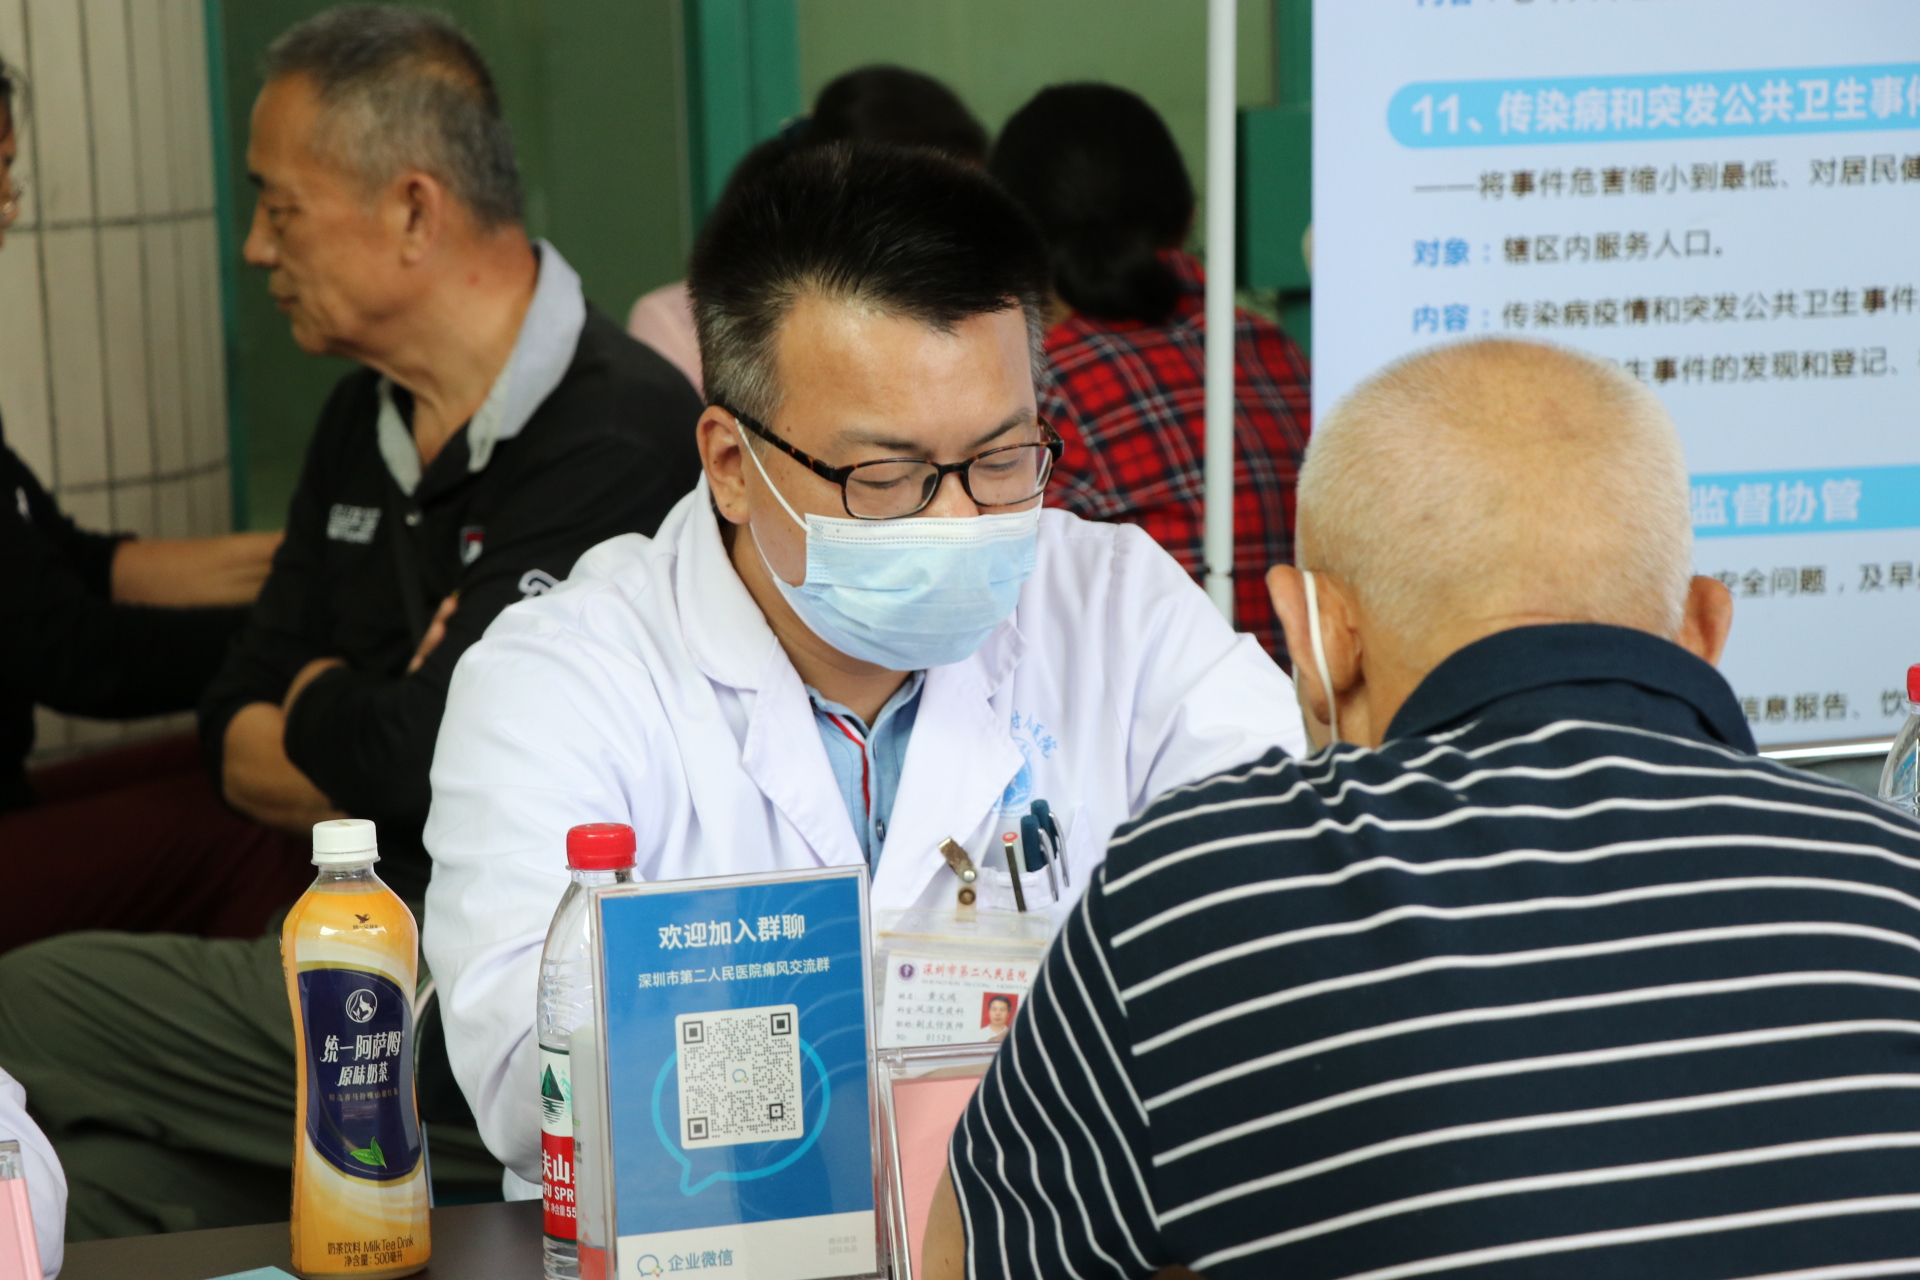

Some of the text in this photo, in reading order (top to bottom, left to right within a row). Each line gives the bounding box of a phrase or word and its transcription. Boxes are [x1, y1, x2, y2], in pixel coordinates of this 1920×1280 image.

[1608, 346, 1898, 384] 生事件的发现和登记、
[1690, 477, 1862, 527] 监督协管
[658, 913, 806, 950] 欢迎加入群聊
[638, 956, 831, 989] 深圳市第二人民医院痛风交流群
[922, 963, 1028, 983] 深圳市第二人民医院
[320, 1031, 401, 1063] 统一阿萨姆
[335, 1061, 389, 1087] 原味奶茶
[542, 1149, 575, 1184] 夫山
[327, 1241, 361, 1255] 奶茶饮料
[396, 1234, 414, 1249] Drink
[668, 1249, 733, 1272] 企业微信
